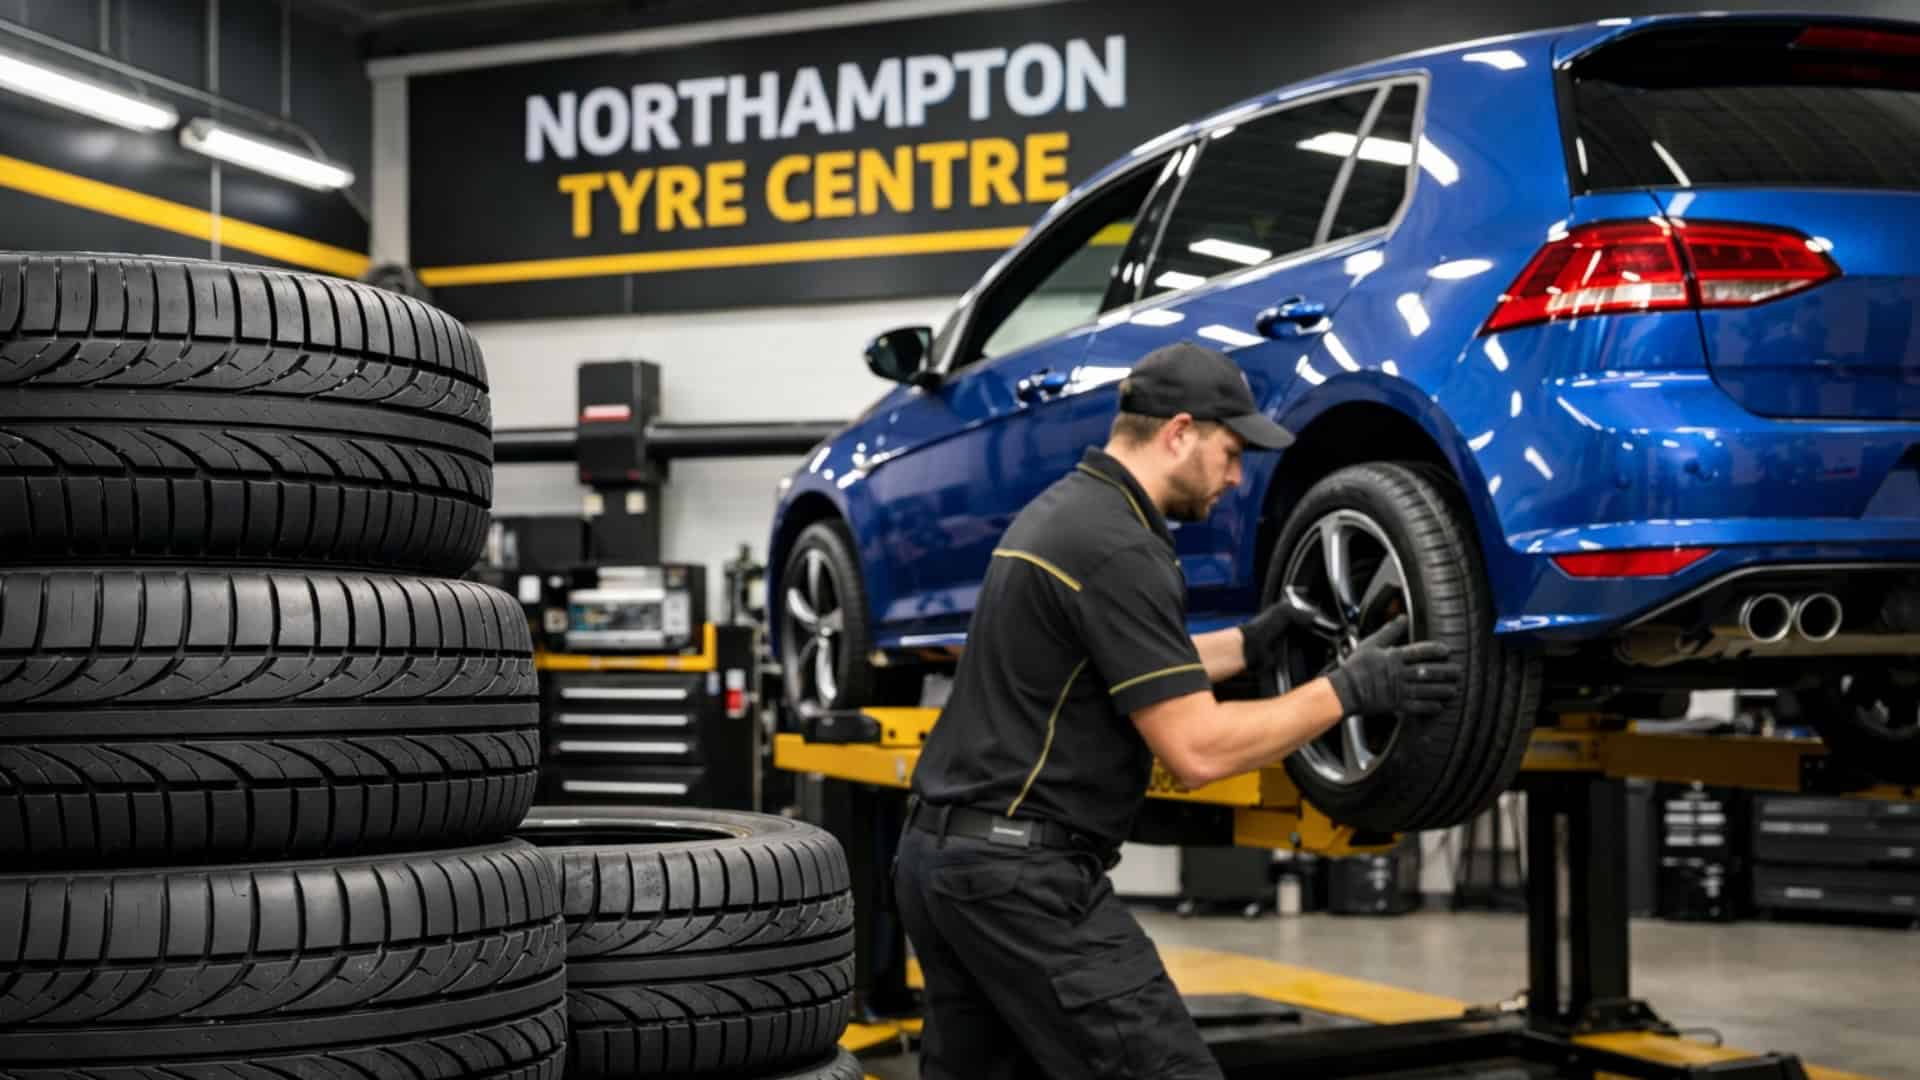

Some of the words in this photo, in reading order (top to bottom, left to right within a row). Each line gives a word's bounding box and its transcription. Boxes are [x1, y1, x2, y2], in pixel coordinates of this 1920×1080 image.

[525, 35, 1126, 162] NORTHAMPTON
[558, 160, 747, 238] TYRE
[765, 132, 1070, 222] CENTRE
